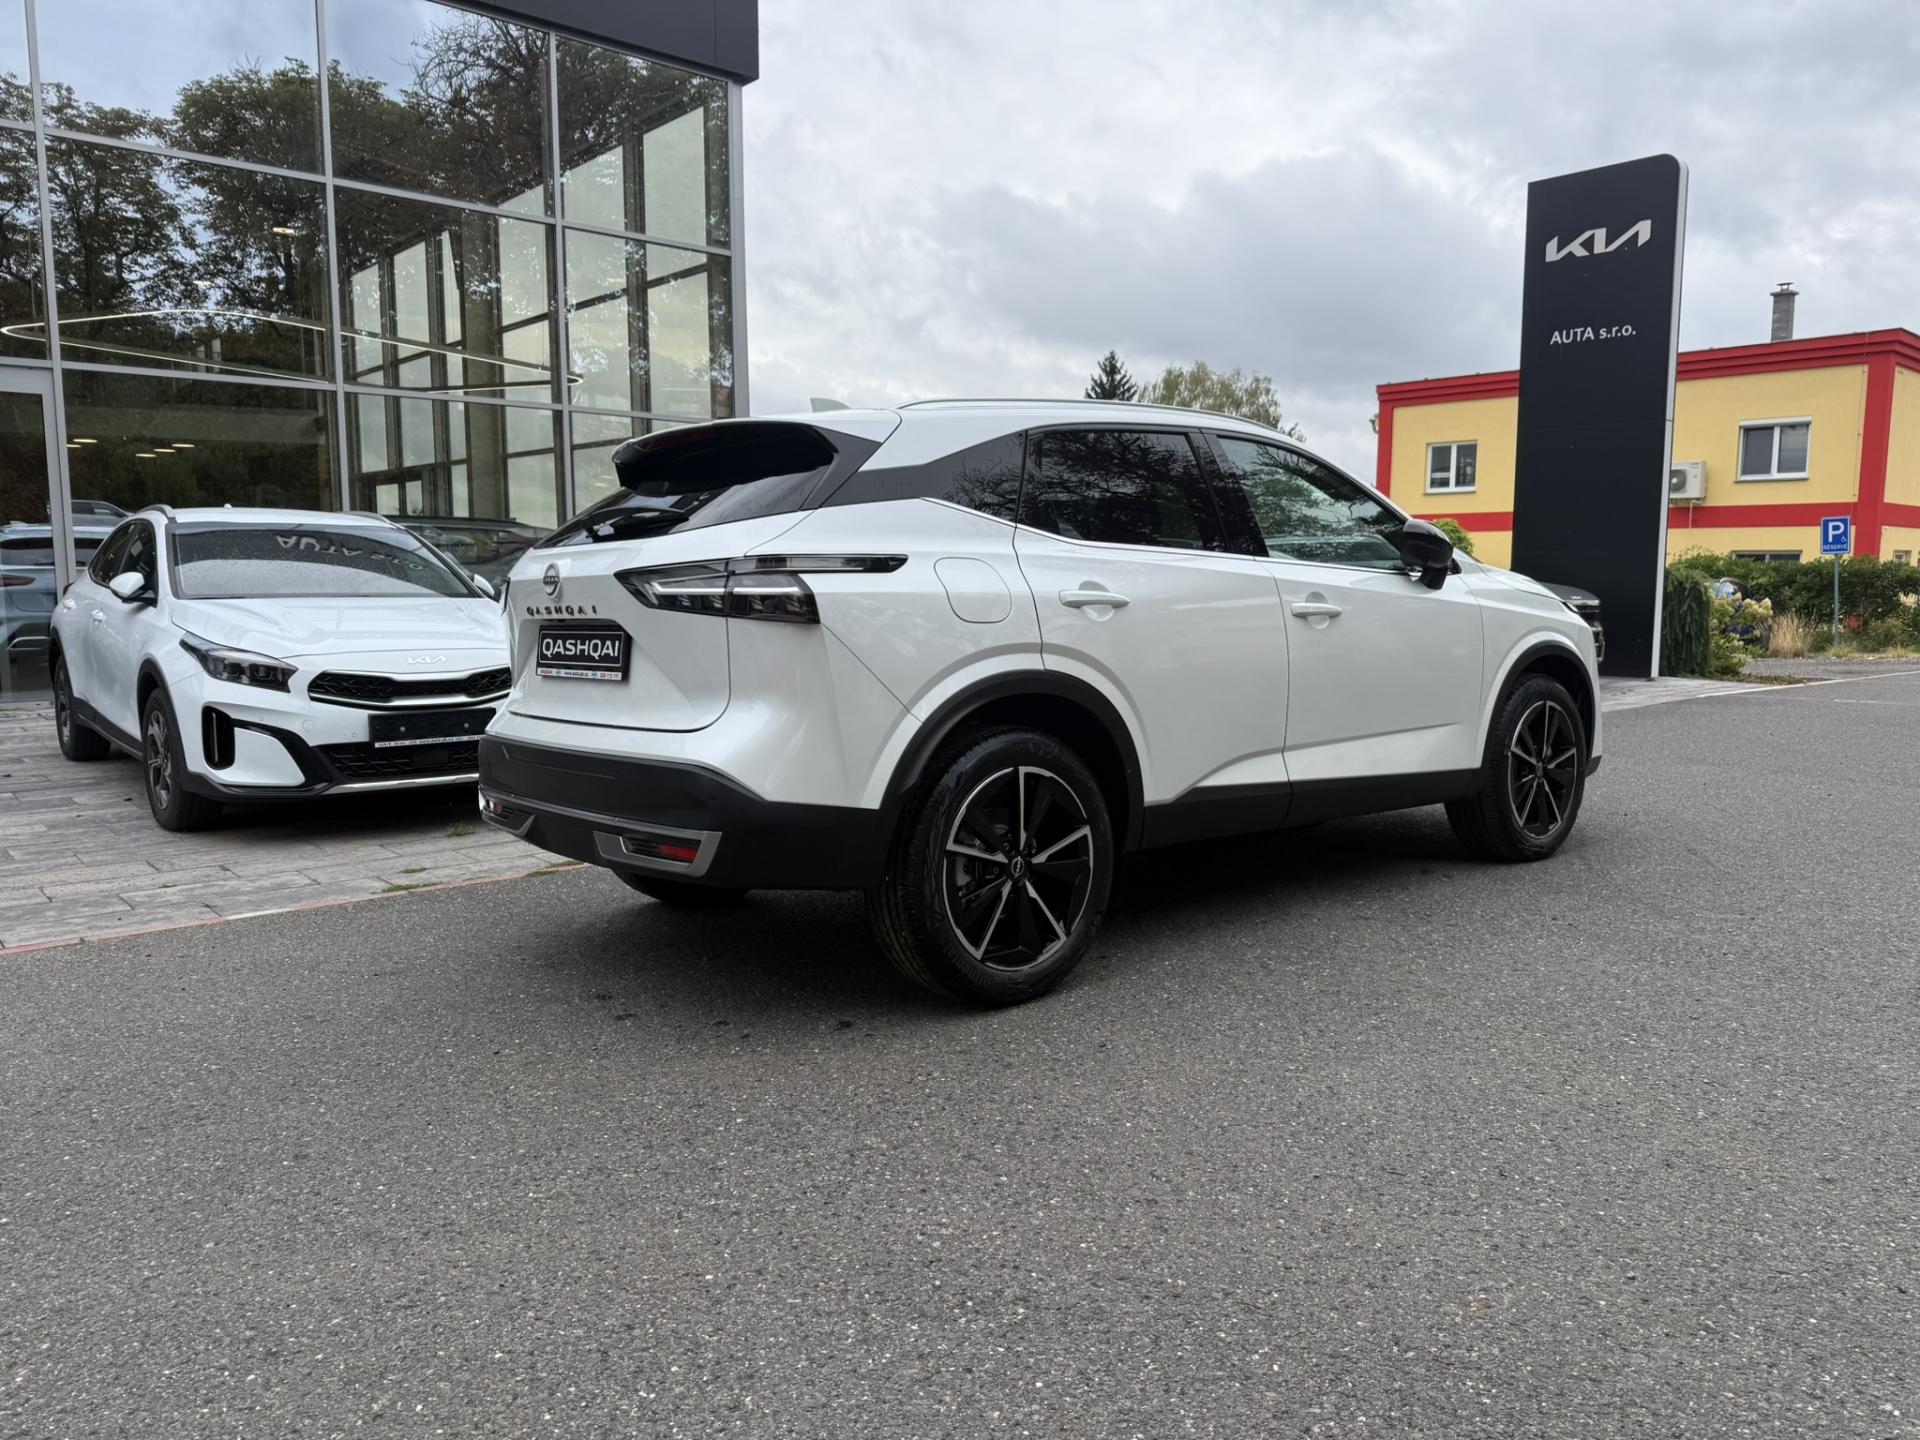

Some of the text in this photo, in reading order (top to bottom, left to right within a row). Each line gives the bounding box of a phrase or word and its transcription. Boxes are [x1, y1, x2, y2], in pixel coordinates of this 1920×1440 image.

[1545, 219, 1652, 263] KIA
[1550, 324, 1637, 345] AUTA s.r.o.
[1828, 521, 1845, 543] P
[526, 605, 598, 617] QASHQAI
[407, 655, 447, 664] KIA
[542, 638, 619, 660] QASHQAI
